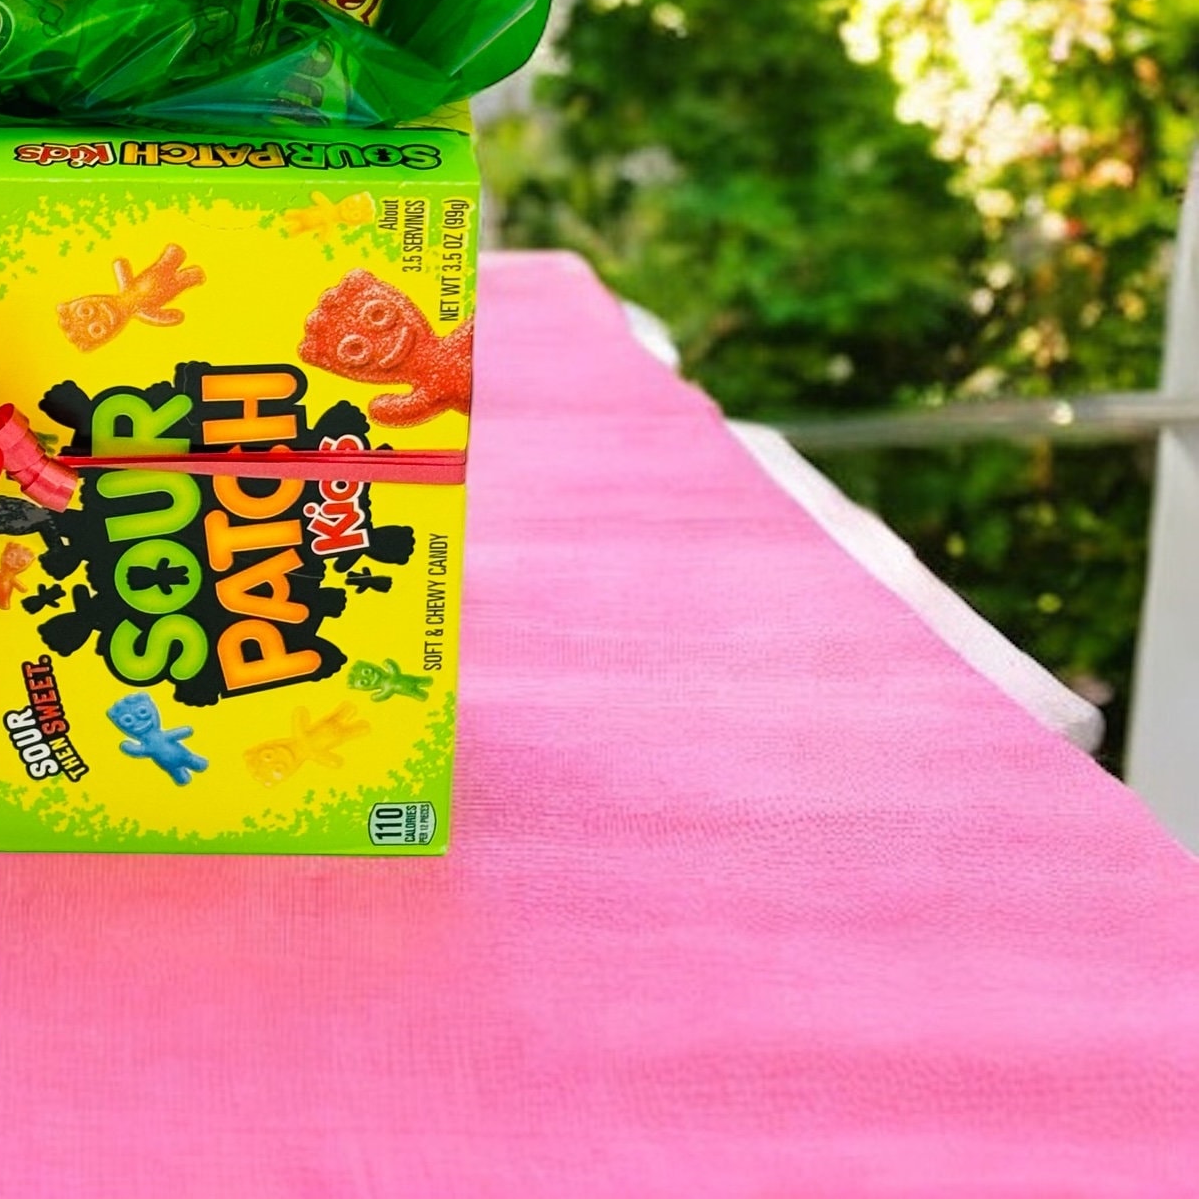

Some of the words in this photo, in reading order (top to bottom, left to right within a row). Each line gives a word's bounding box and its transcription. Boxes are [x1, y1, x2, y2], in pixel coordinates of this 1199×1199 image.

[15, 142, 115, 168] Kids
[120, 141, 288, 168] PATCH
[287, 142, 442, 170] SOUR
[378, 199, 399, 230] About
[403, 200, 425, 253] SERVINGS
[443, 199, 470, 229] (99g)
[443, 233, 463, 249] OZ
[402, 255, 422, 272] 3.5
[442, 253, 462, 271] 3.5
[441, 276, 461, 296] WT
[439, 300, 459, 321] NET
[91, 393, 209, 681] SOUR
[201, 372, 322, 691] PATCH
[428, 533, 449, 576] CANDY
[426, 580, 446, 625] CHEWY
[425, 628, 444, 637] &
[423, 641, 443, 671] SOFT
[6, 708, 59, 778] SOUR
[49, 736, 86, 780] THEN
[375, 808, 404, 840] 110
[404, 805, 417, 842] CALORIES
